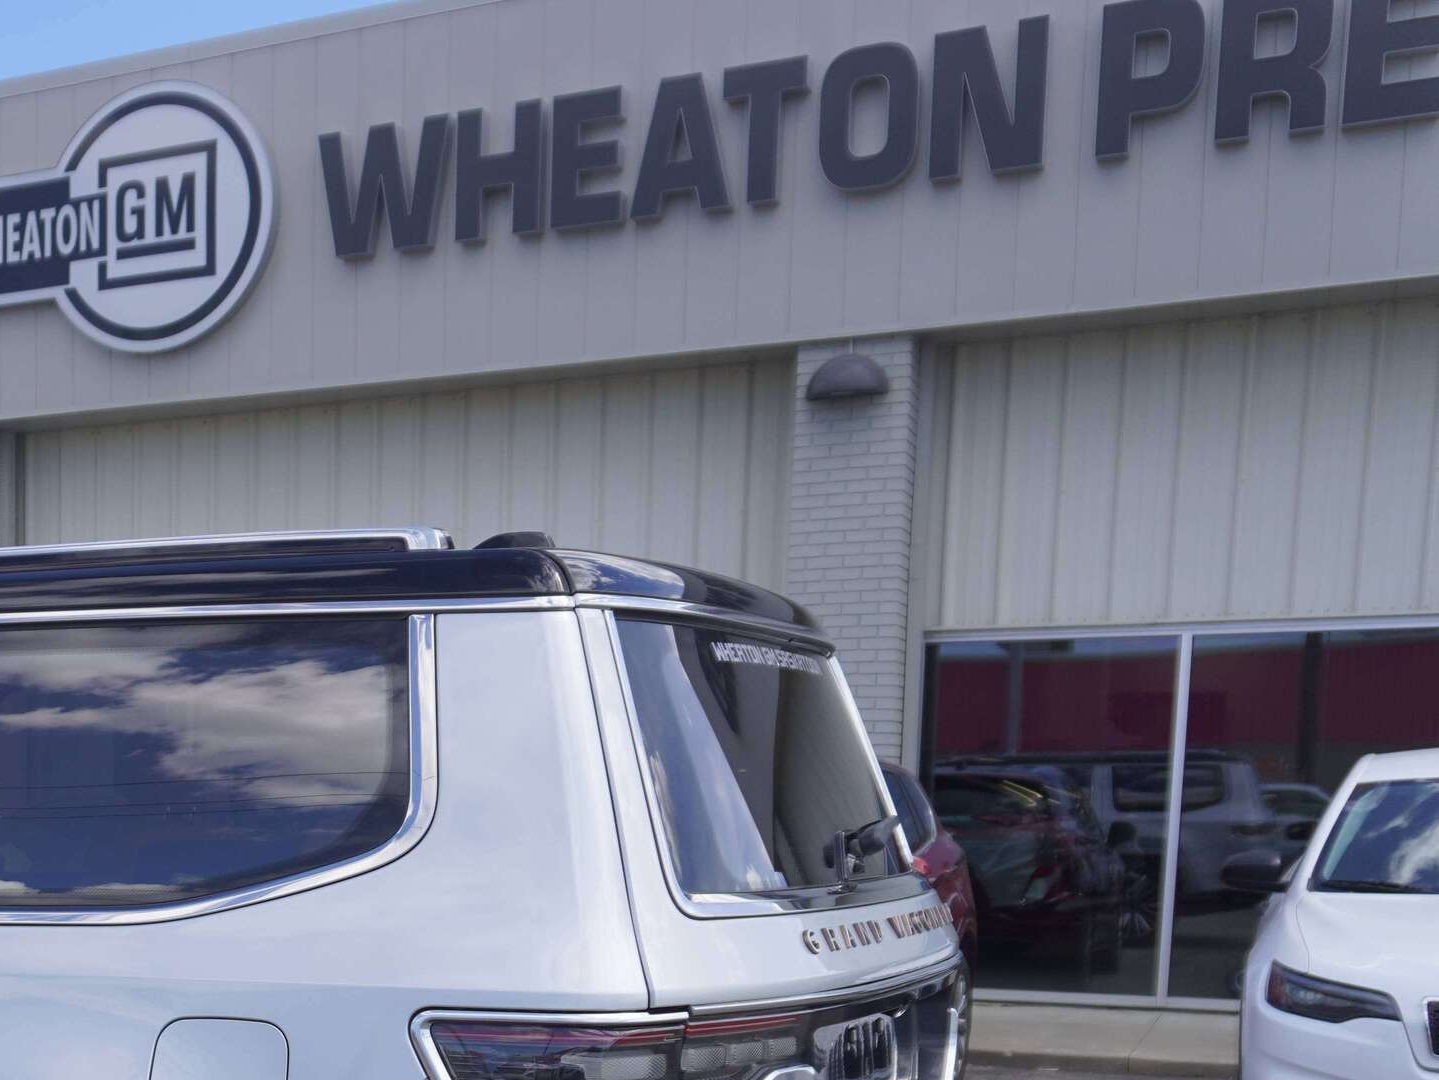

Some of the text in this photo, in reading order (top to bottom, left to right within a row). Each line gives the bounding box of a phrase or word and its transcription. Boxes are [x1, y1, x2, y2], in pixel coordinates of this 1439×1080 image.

[318, 14, 1051, 260] WHEATON
[115, 171, 197, 243] GM
[802, 920, 883, 955] GRAND
